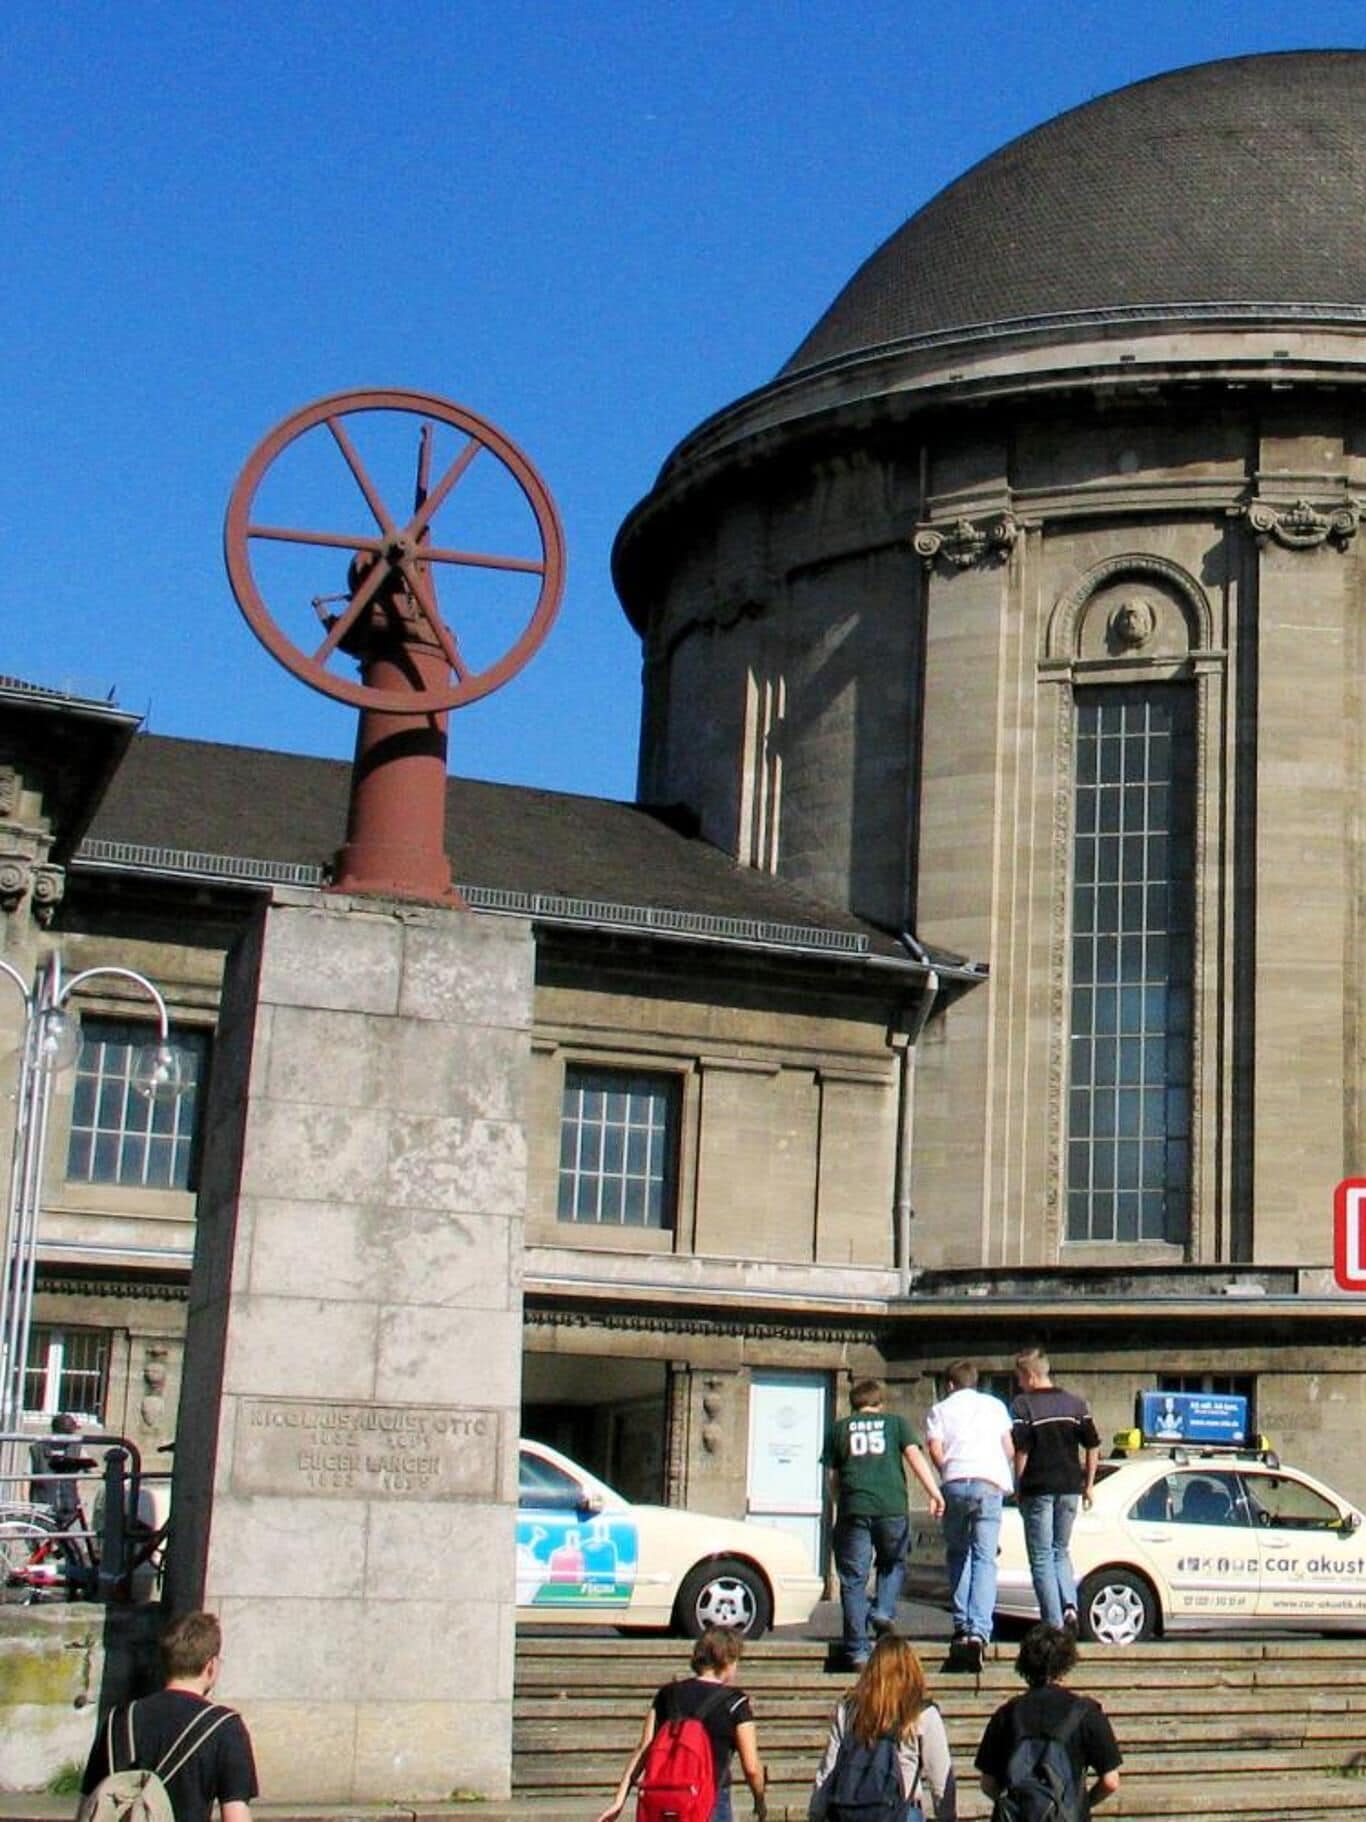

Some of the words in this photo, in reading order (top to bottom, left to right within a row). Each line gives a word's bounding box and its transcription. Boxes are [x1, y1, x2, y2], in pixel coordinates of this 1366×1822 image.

[431, 1417, 488, 1436] OTTO
[849, 1420, 885, 1432] CREW
[850, 1433, 885, 1456] 05
[1265, 1558, 1299, 1572] car
